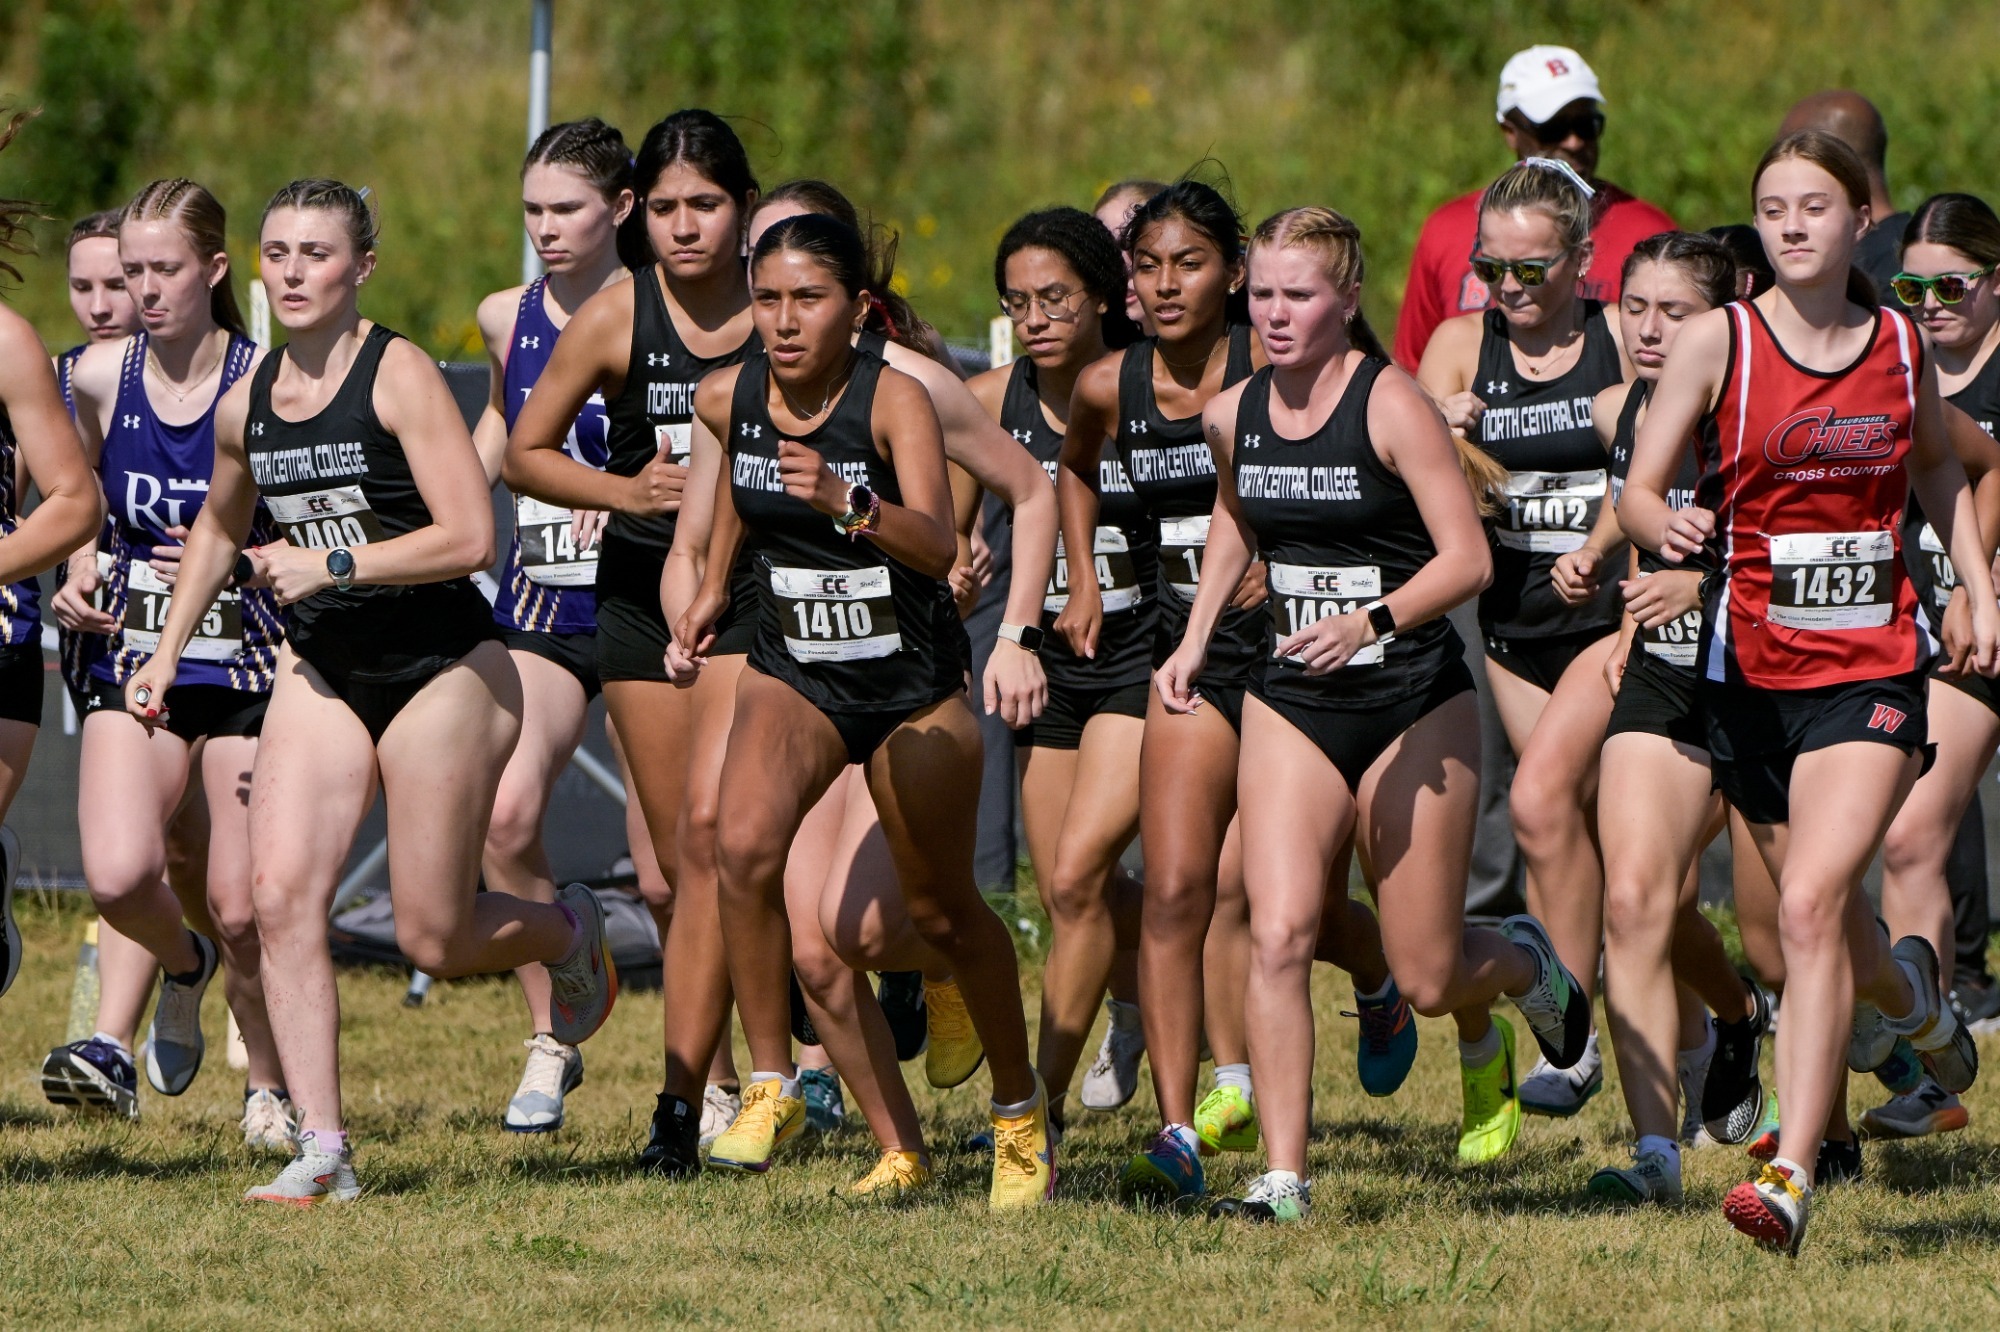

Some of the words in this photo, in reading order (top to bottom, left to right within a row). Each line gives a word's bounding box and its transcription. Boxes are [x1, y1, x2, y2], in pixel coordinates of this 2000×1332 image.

[1545, 58, 1569, 78] B
[647, 382, 687, 415] NORTH
[1482, 406, 1520, 442] NORTH
[1521, 399, 1574, 437] CENTRAL
[1764, 406, 1899, 468] CHIEFS
[1834, 416, 1886, 426] WAUBONSEE
[272, 447, 317, 484] CENTRAL
[315, 442, 369, 478] COLLEGE
[733, 452, 769, 491] NORTH
[1099, 460, 1135, 493] OLLE
[1131, 448, 1168, 482] NORTH
[1165, 442, 1217, 479] CENTRAL
[1773, 468, 1826, 482] CROSS
[1238, 464, 1267, 498] NORTH
[1264, 466, 1310, 499] CENTRAL
[1311, 466, 1362, 500] COLLEGE
[1508, 498, 1587, 531] 1402
[1831, 539, 1858, 557] CC
[823, 578, 848, 595] CC
[1313, 575, 1338, 592] CC
[1791, 564, 1876, 605] 1432
[793, 602, 873, 639] 1410
[1867, 703, 1907, 734] W
